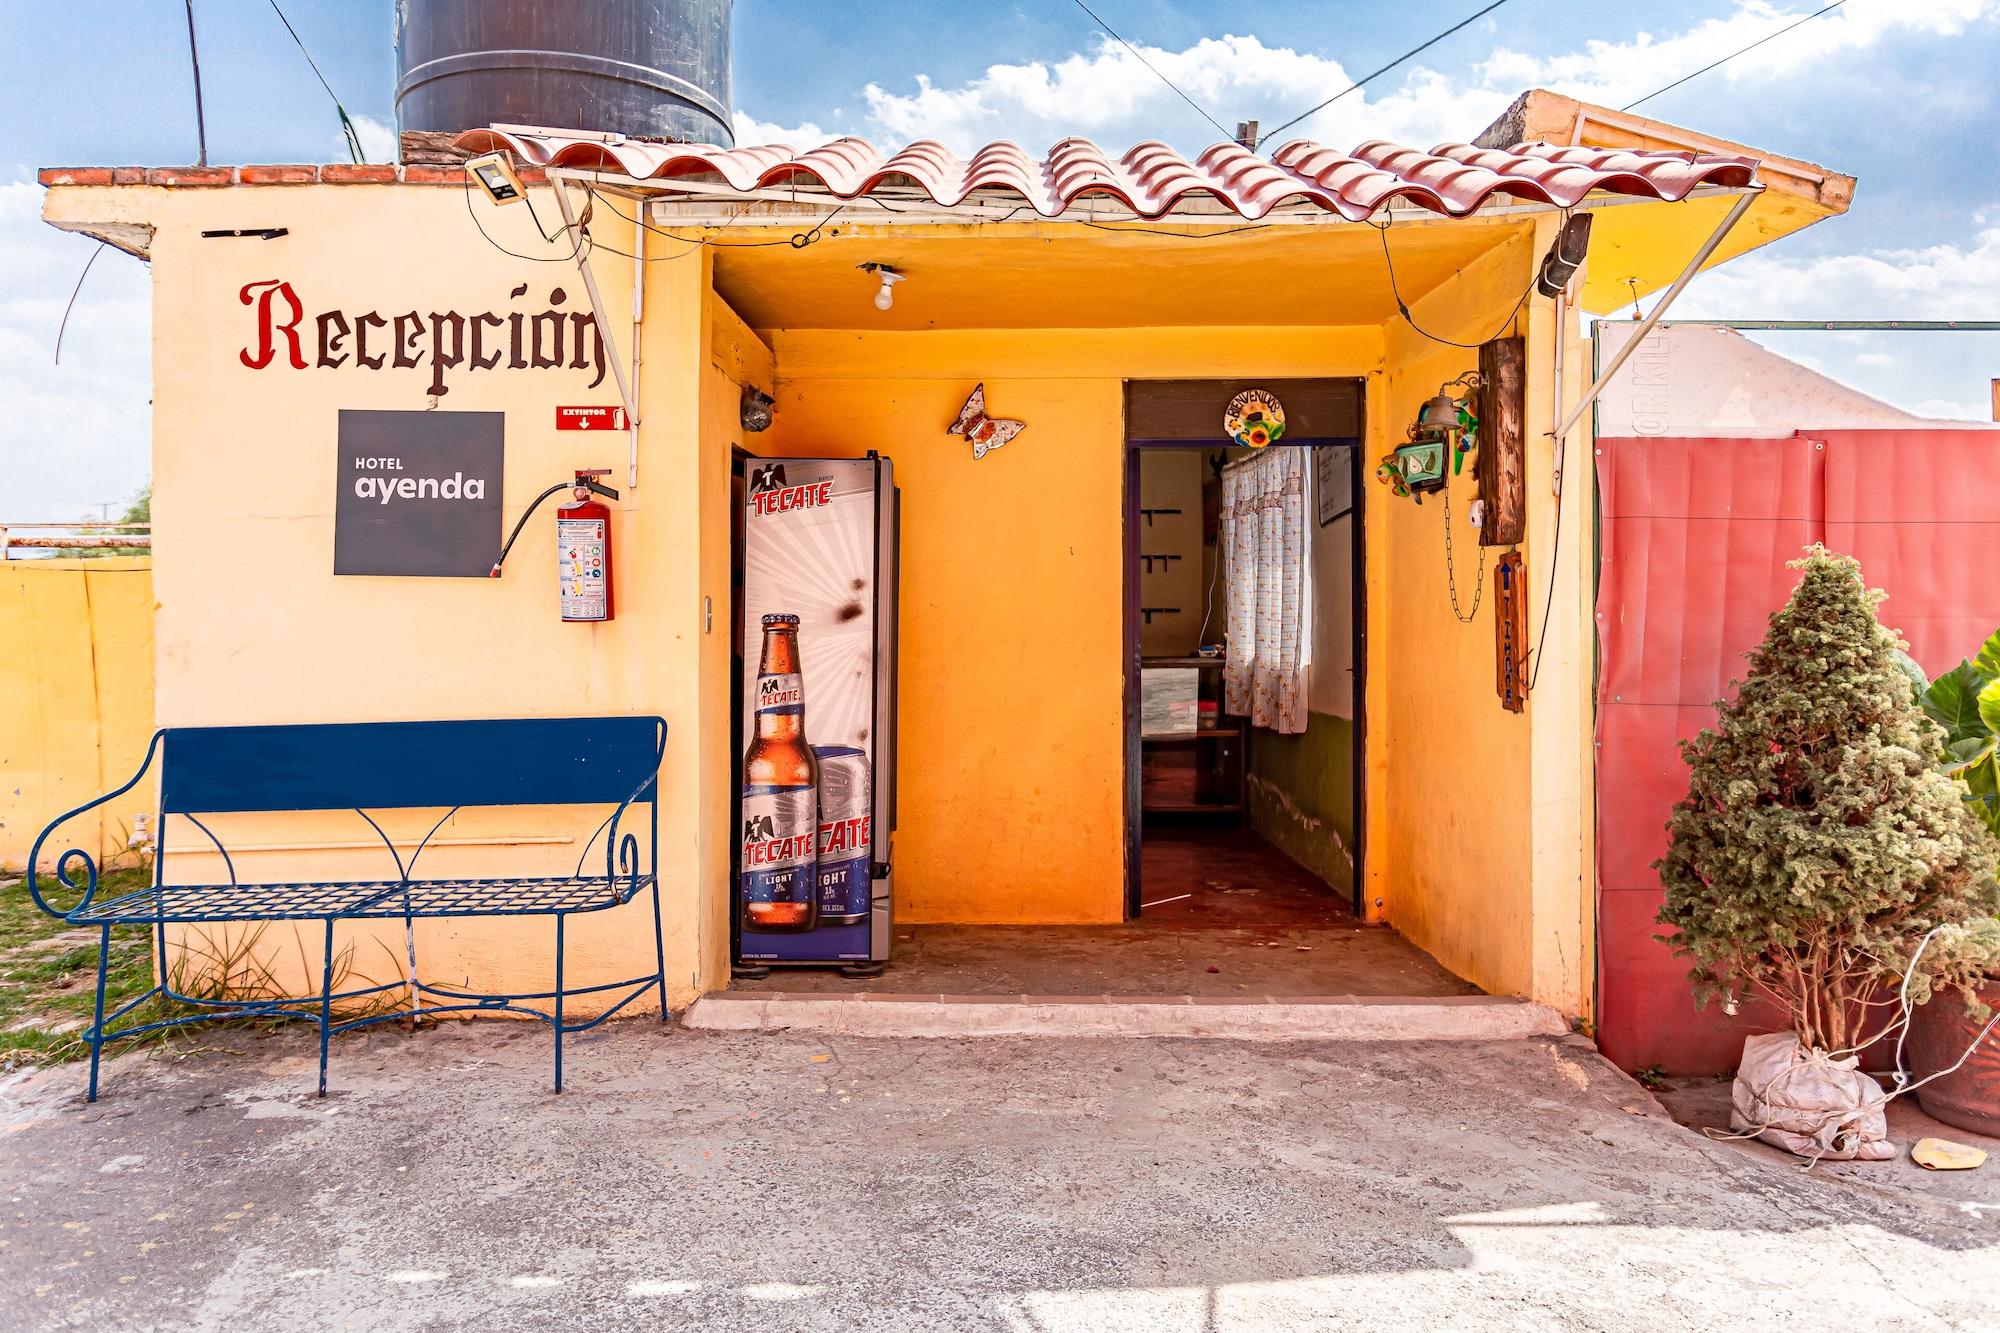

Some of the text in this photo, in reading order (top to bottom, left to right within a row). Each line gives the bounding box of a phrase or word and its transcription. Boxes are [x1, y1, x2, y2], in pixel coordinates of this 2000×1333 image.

[562, 408, 606, 417] EXTINTOR
[355, 457, 404, 470] HOTEL
[354, 472, 485, 504] ayenda
[750, 480, 835, 517] TECATE
[760, 690, 800, 706] TECATE
[744, 832, 814, 866] TECATE
[765, 873, 793, 885] LIGHT
